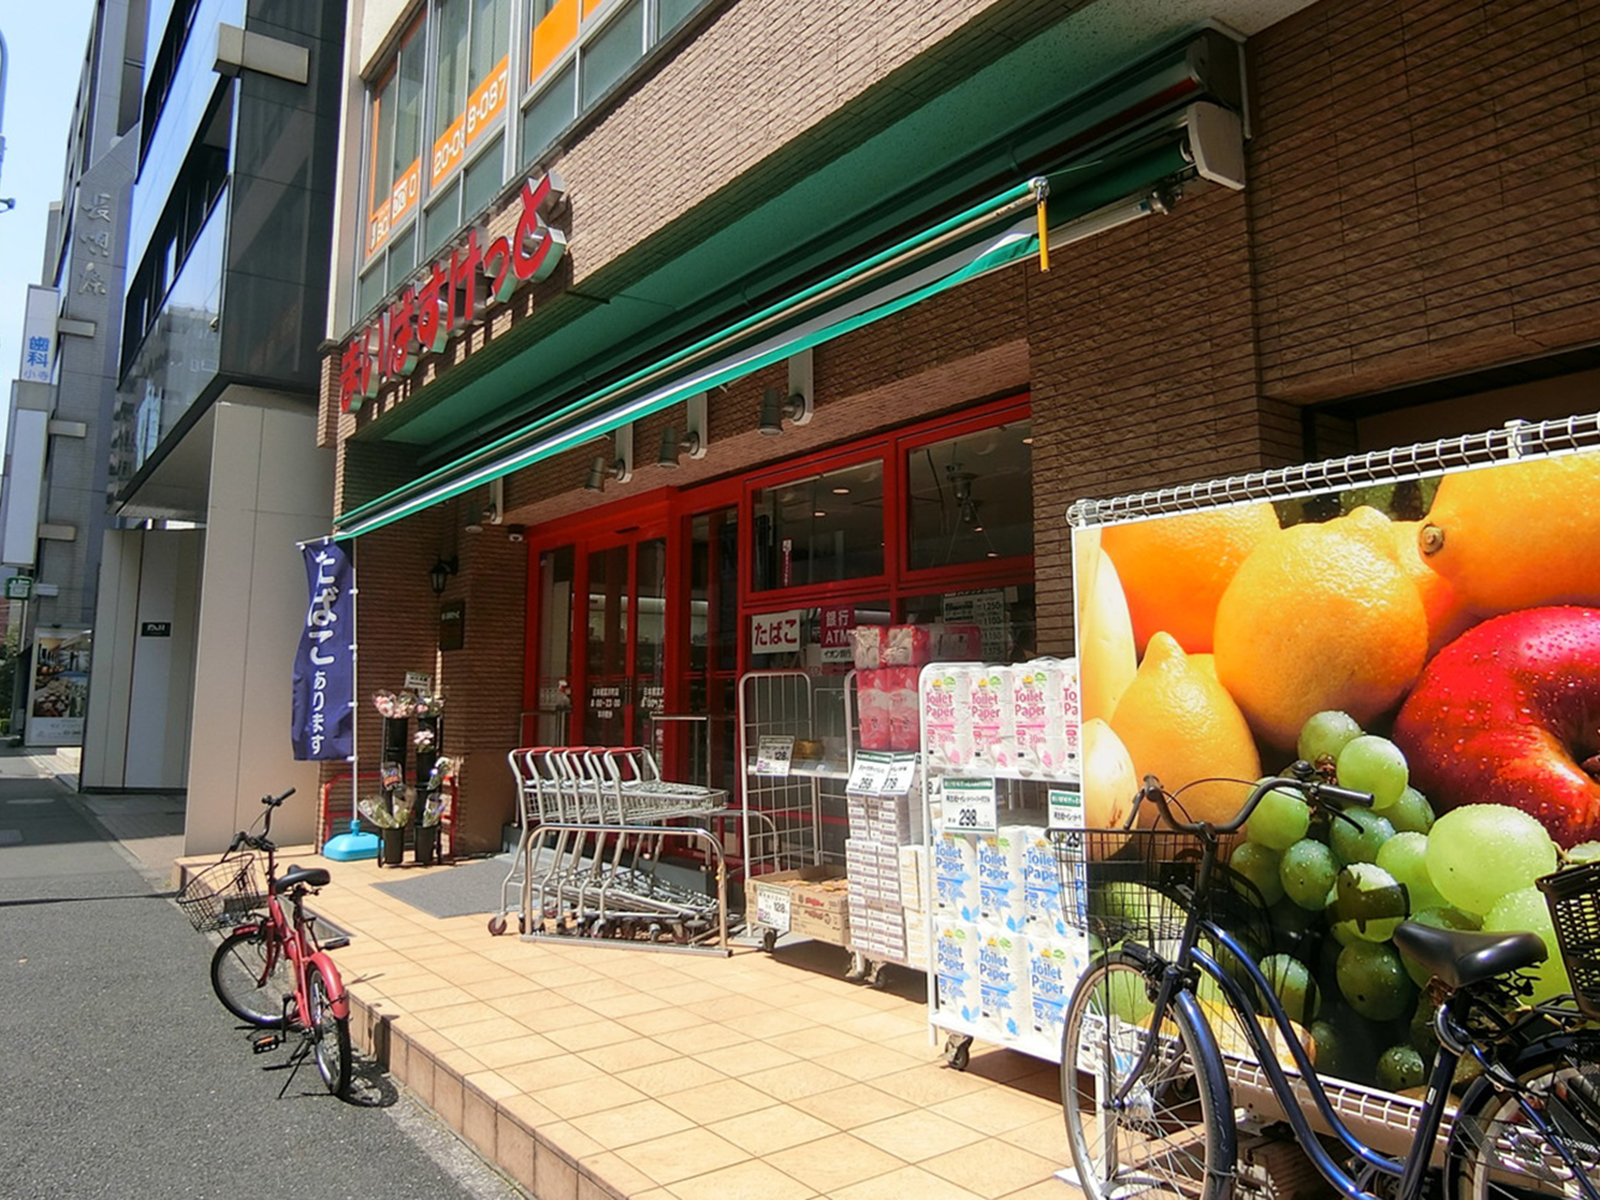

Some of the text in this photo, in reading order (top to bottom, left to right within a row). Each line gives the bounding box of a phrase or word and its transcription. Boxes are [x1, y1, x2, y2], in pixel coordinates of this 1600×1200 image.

[340, 175, 557, 413] まいばすけっと
[27, 335, 50, 368] 歯科
[308, 551, 340, 666] たばこ
[825, 609, 850, 627] 銀行
[754, 618, 798, 646] たばこ
[825, 629, 850, 645] ATM
[925, 691, 953, 703] Toilet
[971, 691, 998, 704] Toilet
[1014, 689, 1043, 703] Toilet
[310, 670, 326, 755] あります
[925, 705, 955, 717] Paper
[971, 706, 1000, 718] Paper
[1014, 704, 1046, 717] Paper
[959, 808, 977, 827] 298
[935, 842, 962, 859] Toilet
[979, 849, 1007, 867] Toilet
[936, 857, 964, 873] Paper
[980, 864, 1009, 881] Paper
[937, 938, 963, 958] Toilet
[937, 953, 965, 971] Paper
[979, 948, 1009, 969] Toilet
[979, 963, 1010, 982] Paper
[1031, 959, 1062, 980] Toilet
[1032, 974, 1065, 994] Paper
